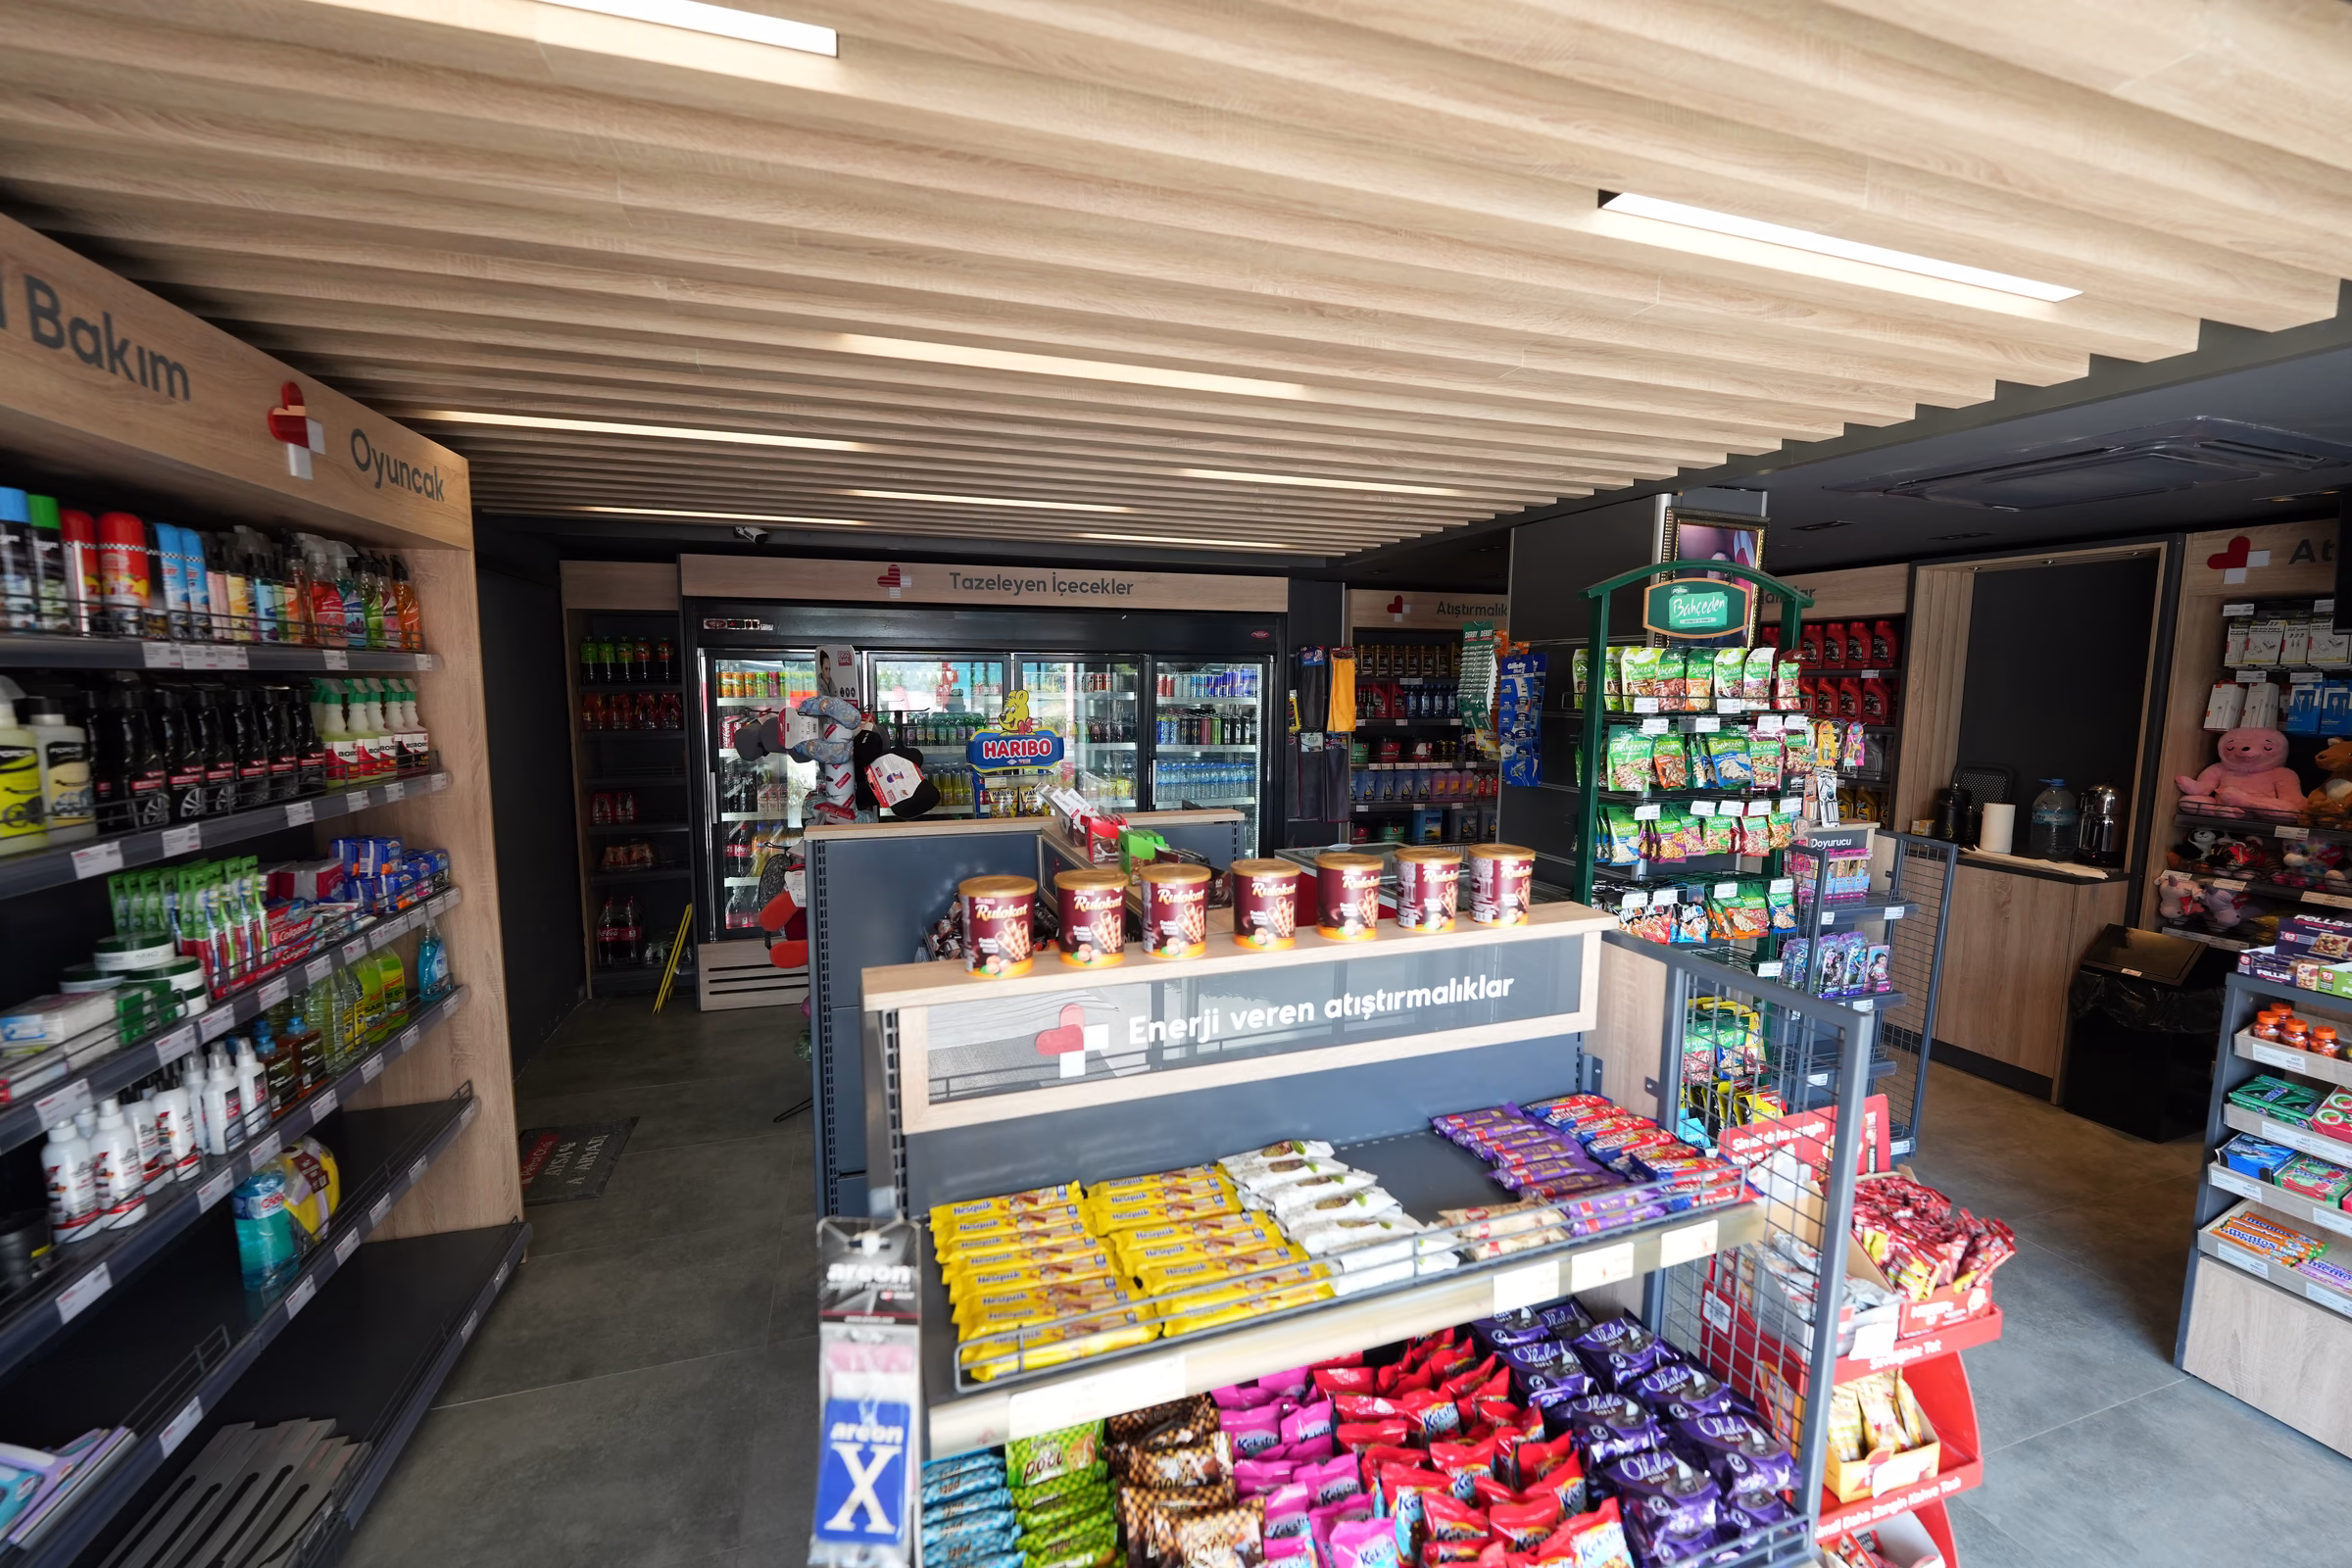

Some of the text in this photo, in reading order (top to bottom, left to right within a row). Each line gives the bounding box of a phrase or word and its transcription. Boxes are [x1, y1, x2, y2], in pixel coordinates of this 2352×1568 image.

[24, 274, 191, 401] Bakım
[350, 427, 445, 503] Oyuncak
[949, 571, 1135, 597] Tazeleyen İçecekler
[1673, 596, 1725, 617] Bahçeden
[1464, 630, 1479, 639] DERBY
[983, 739, 1053, 760] HARIBO
[1811, 838, 1852, 850] Doyurucu
[1157, 888, 1205, 906] Rulokat
[1251, 882, 1296, 898] Rulokat
[1074, 895, 1123, 912] Rulokat
[975, 904, 1028, 921] Rulokat
[279, 923, 309, 942] Colgate
[1128, 973, 1515, 1045] Enerji veren atıştırmalıklar
[1109, 1177, 1145, 1188] Nesquik
[1111, 1193, 1148, 1203] Nesquik
[954, 1201, 993, 1216] Nesquik
[1112, 1209, 1150, 1220] Nesquik
[959, 1219, 999, 1232] Nesquik
[1136, 1227, 1175, 1239] Nesquik
[2229, 1227, 2277, 1250] mentos
[1145, 1245, 1186, 1257] Nesquik
[826, 1262, 911, 1283] areon
[1165, 1262, 1207, 1276] Nesquik
[977, 1271, 1020, 1285] Nesquik
[983, 1291, 1027, 1305] Nesquik
[829, 1421, 904, 1443] areon
[823, 1442, 902, 1536] X
